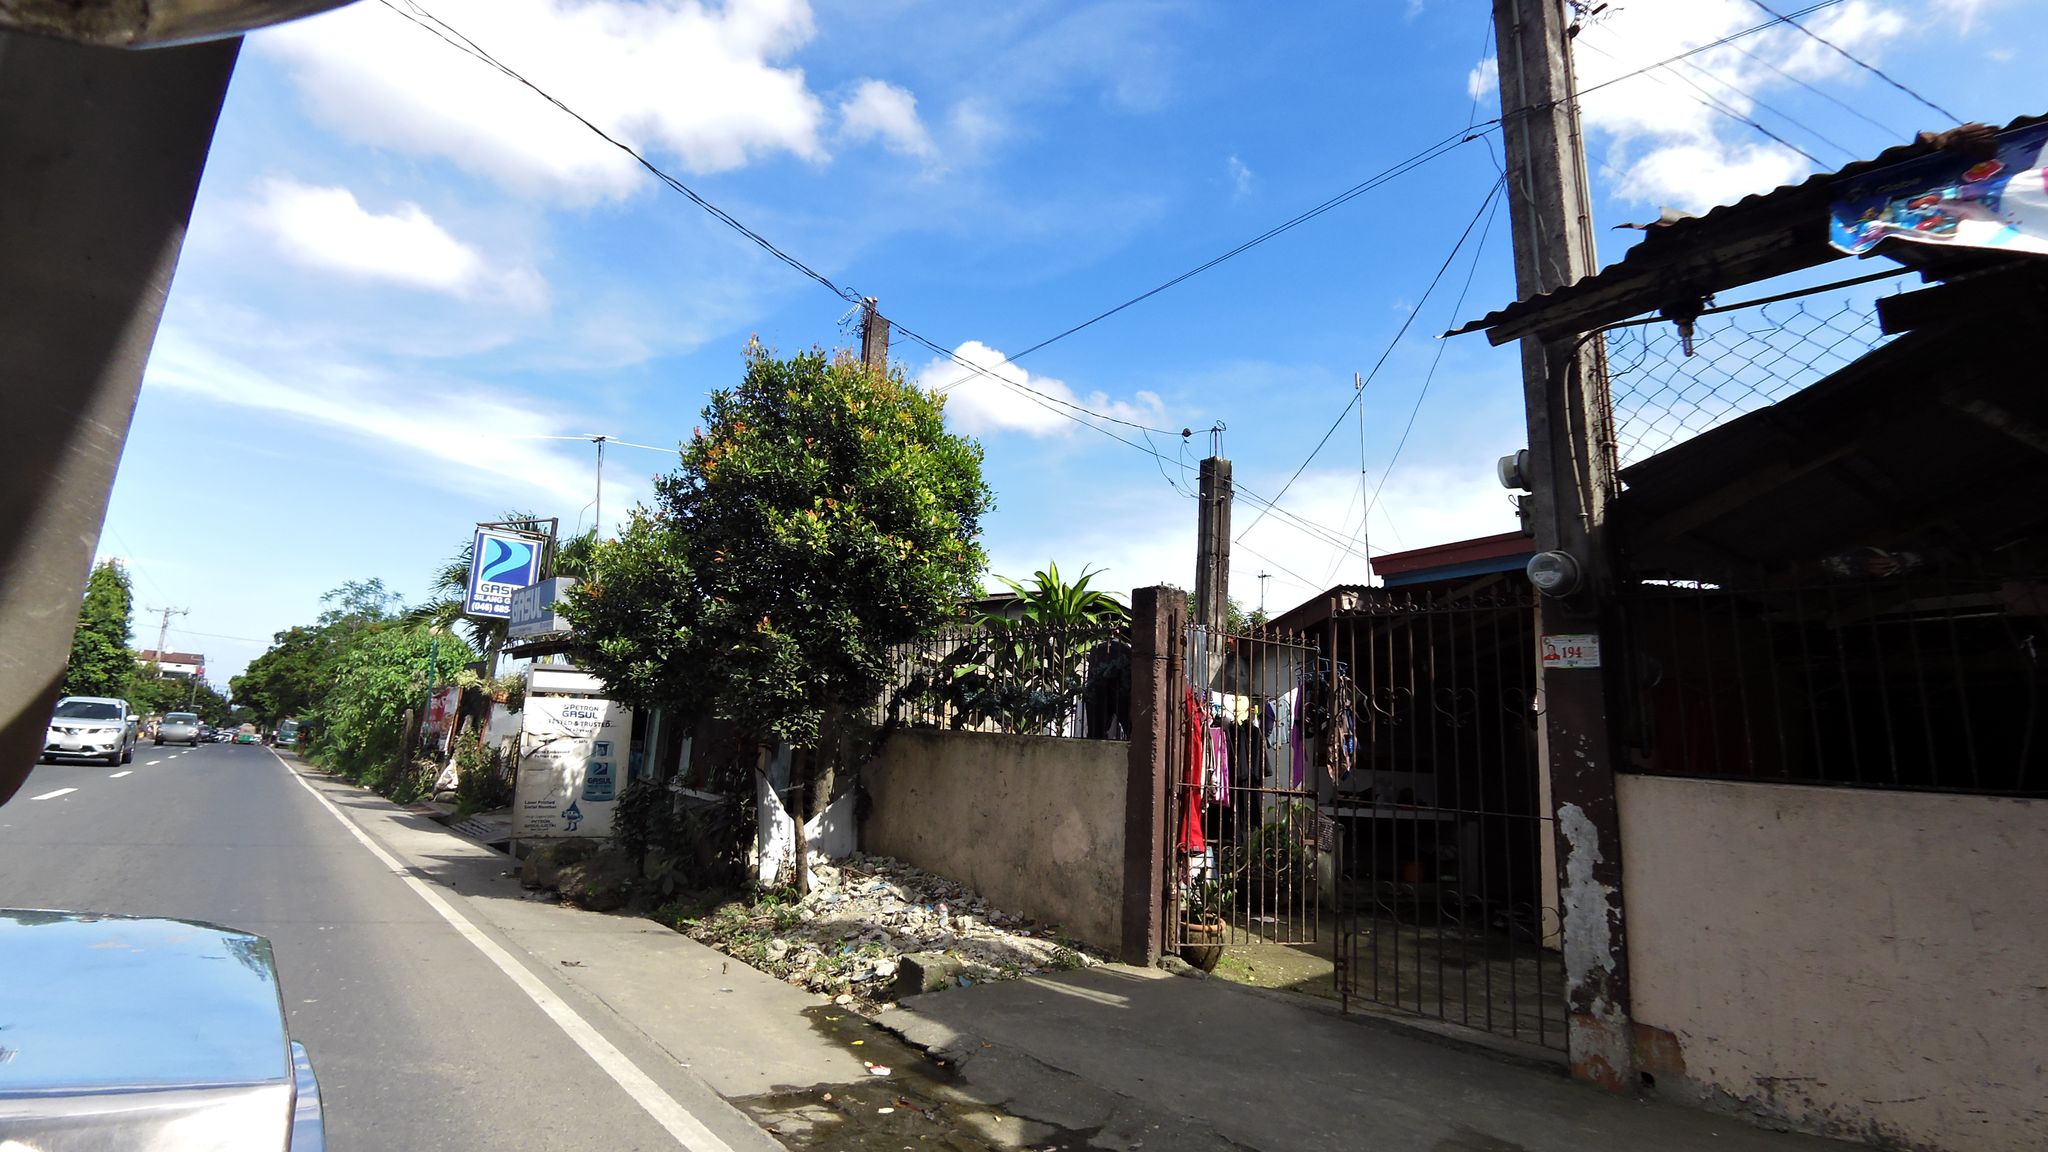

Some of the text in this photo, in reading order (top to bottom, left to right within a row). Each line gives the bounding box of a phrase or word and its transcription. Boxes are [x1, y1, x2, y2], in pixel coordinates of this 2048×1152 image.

[474, 595, 502, 604] SILANG
[512, 586, 543, 623] GASUL
[1562, 646, 1583, 658] 194
[562, 710, 598, 719] GASUL
[588, 777, 612, 785] GASUL
